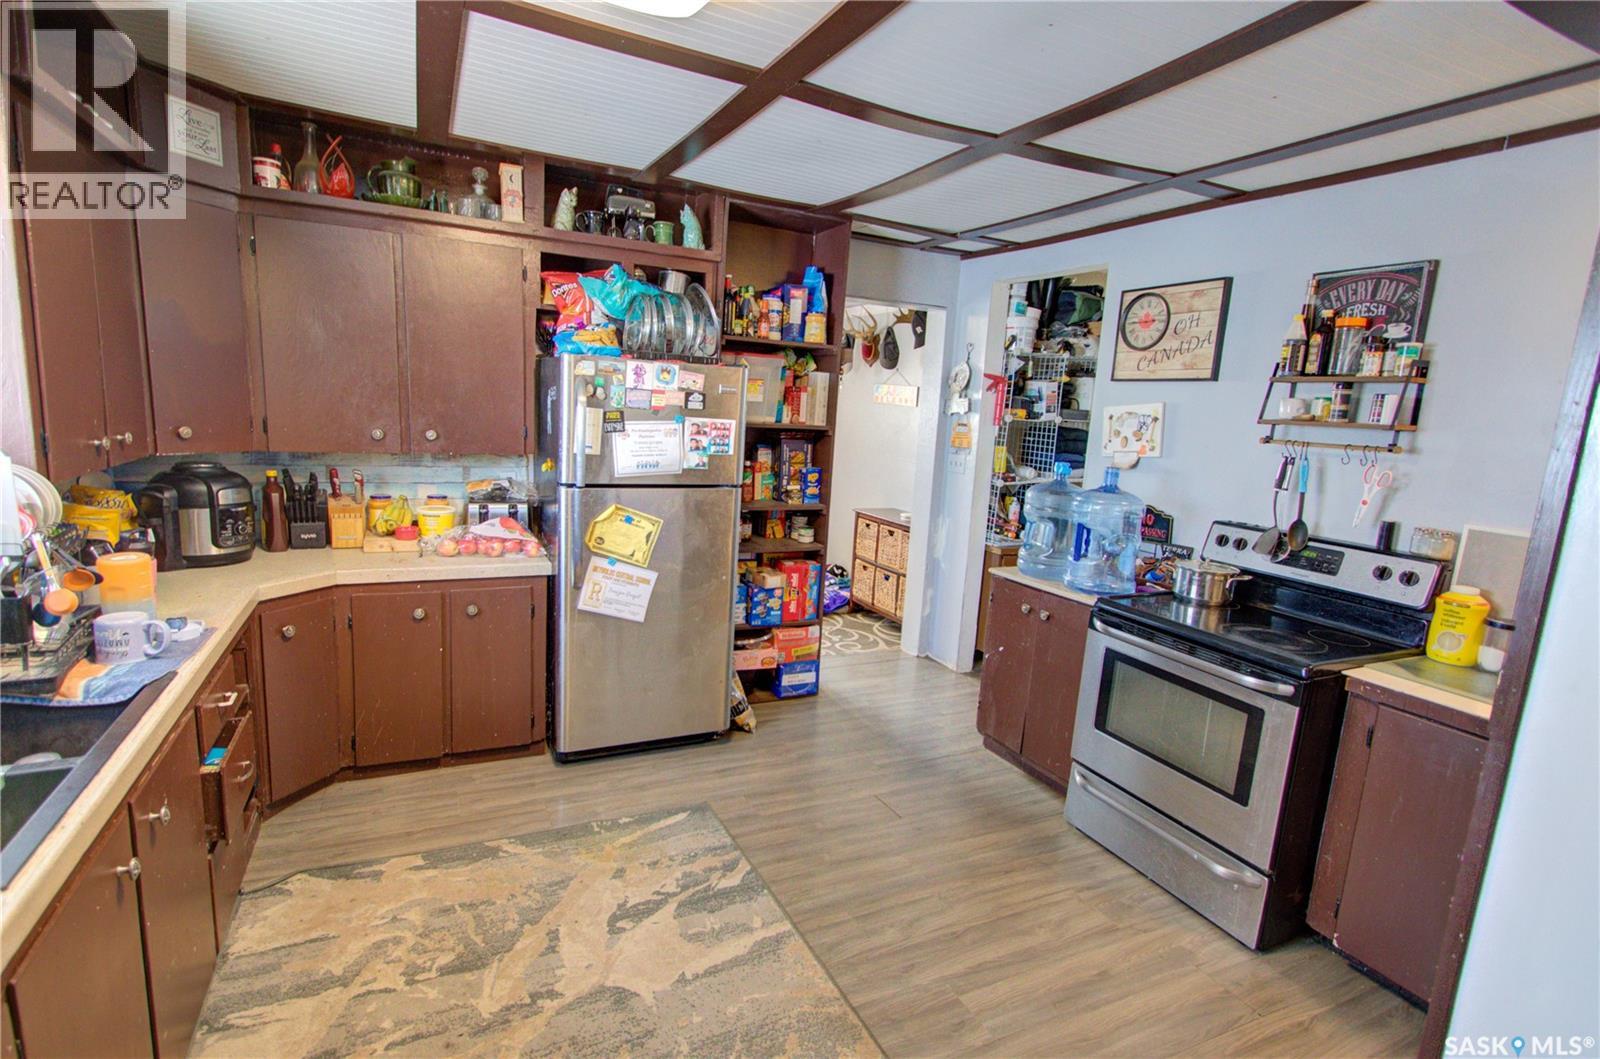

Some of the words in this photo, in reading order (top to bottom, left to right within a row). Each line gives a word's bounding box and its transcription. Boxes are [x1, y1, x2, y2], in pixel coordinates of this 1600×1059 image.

[551, 282, 577, 297] Doritos
[1328, 279, 1377, 309] EVERY
[1374, 279, 1409, 304] DAY
[1346, 302, 1387, 318] FRESH
[1173, 313, 1201, 336] OH
[1136, 329, 1213, 371] CANADA
